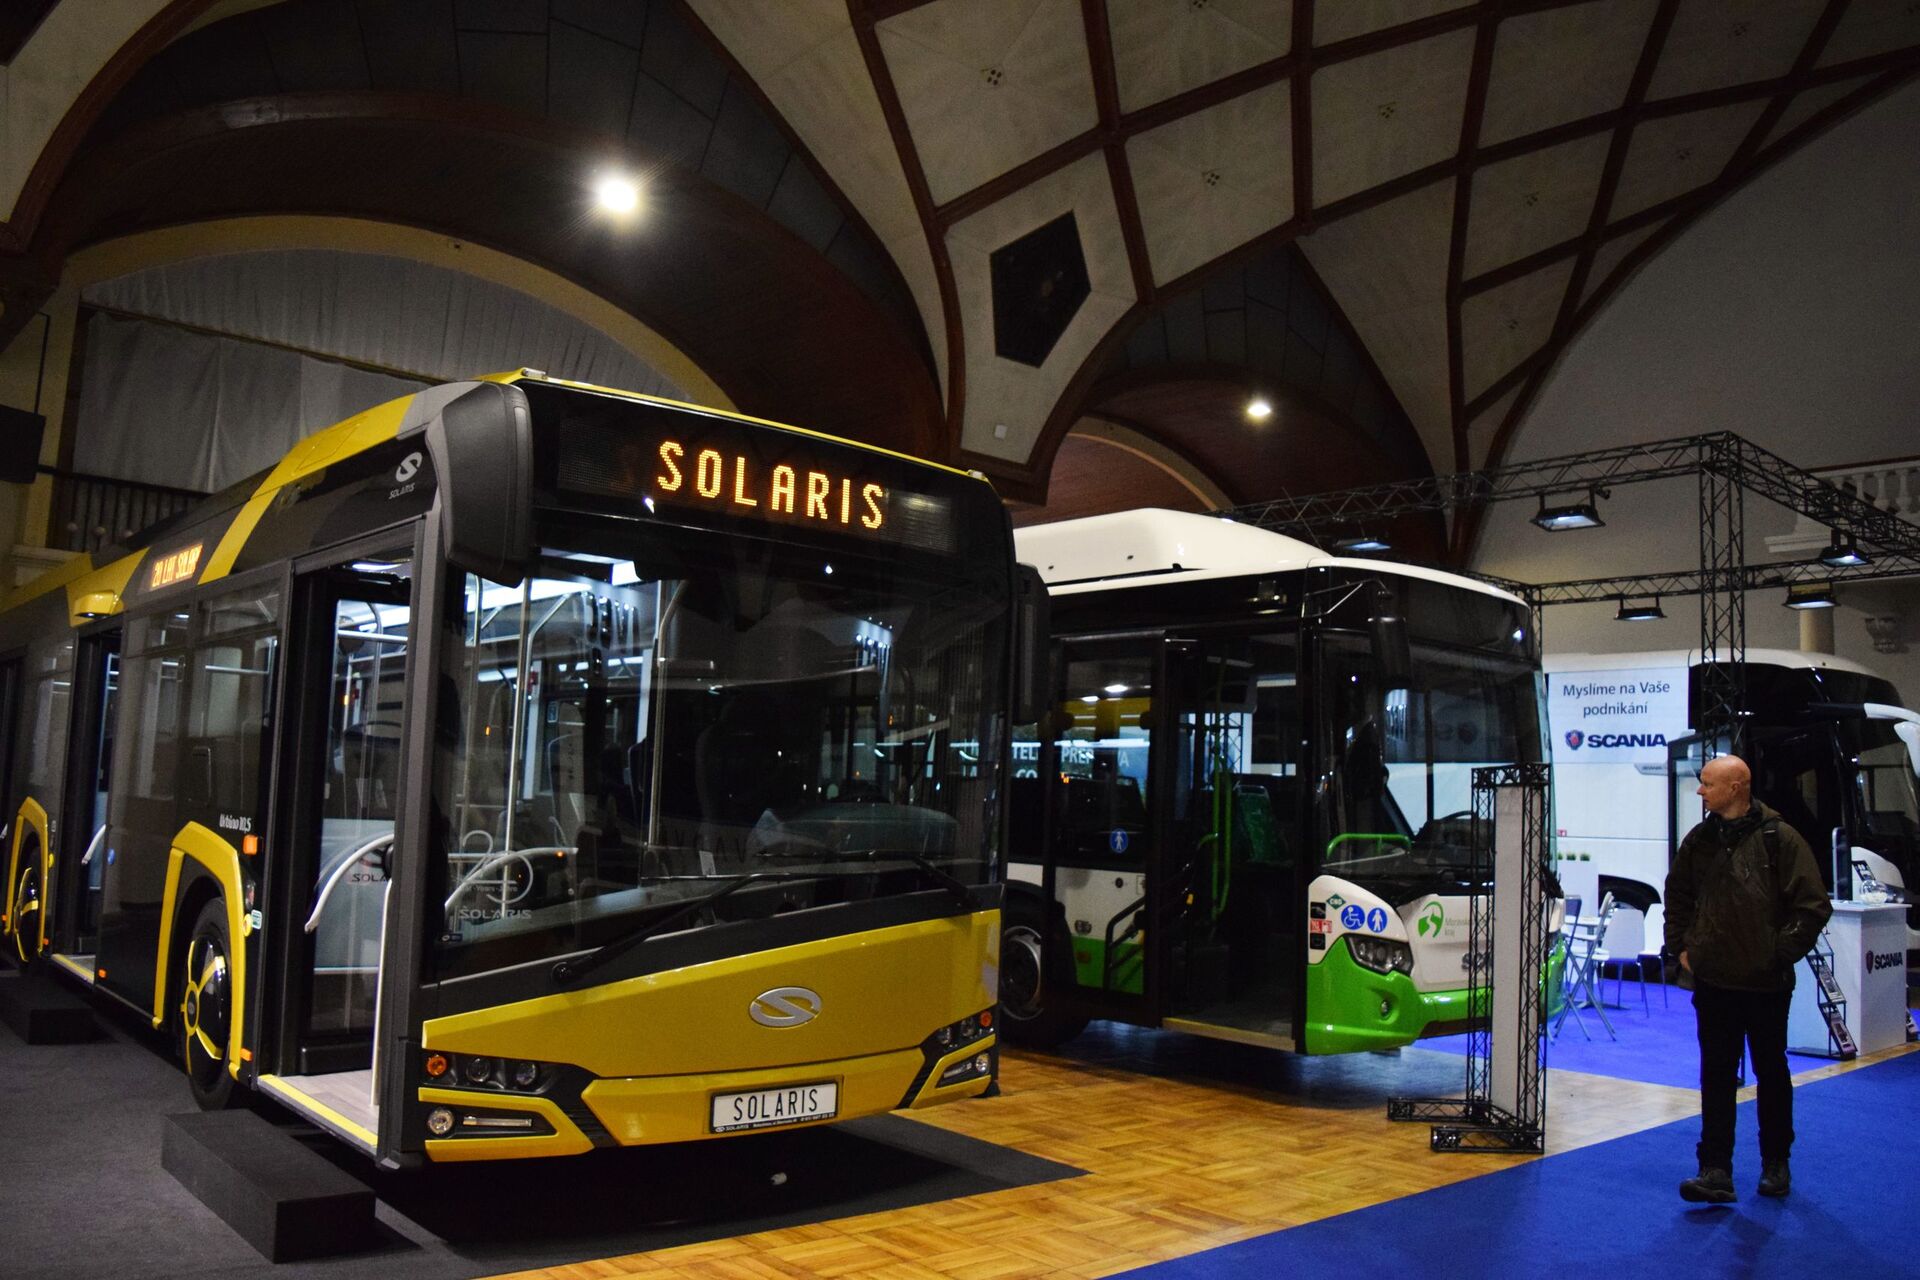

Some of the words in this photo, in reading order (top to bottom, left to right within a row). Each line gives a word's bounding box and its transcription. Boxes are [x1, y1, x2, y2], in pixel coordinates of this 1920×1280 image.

[657, 441, 884, 529] SOLARIS
[1563, 683, 1616, 699] Myslíme
[1620, 684, 1636, 695] na
[1640, 681, 1670, 694] Vaše
[1583, 702, 1648, 718] podnikání
[1588, 734, 1668, 748] SCANIA
[459, 908, 532, 920] SOLARIS
[1874, 951, 1903, 970] SCANIA
[734, 1088, 818, 1122] SOLARIS
